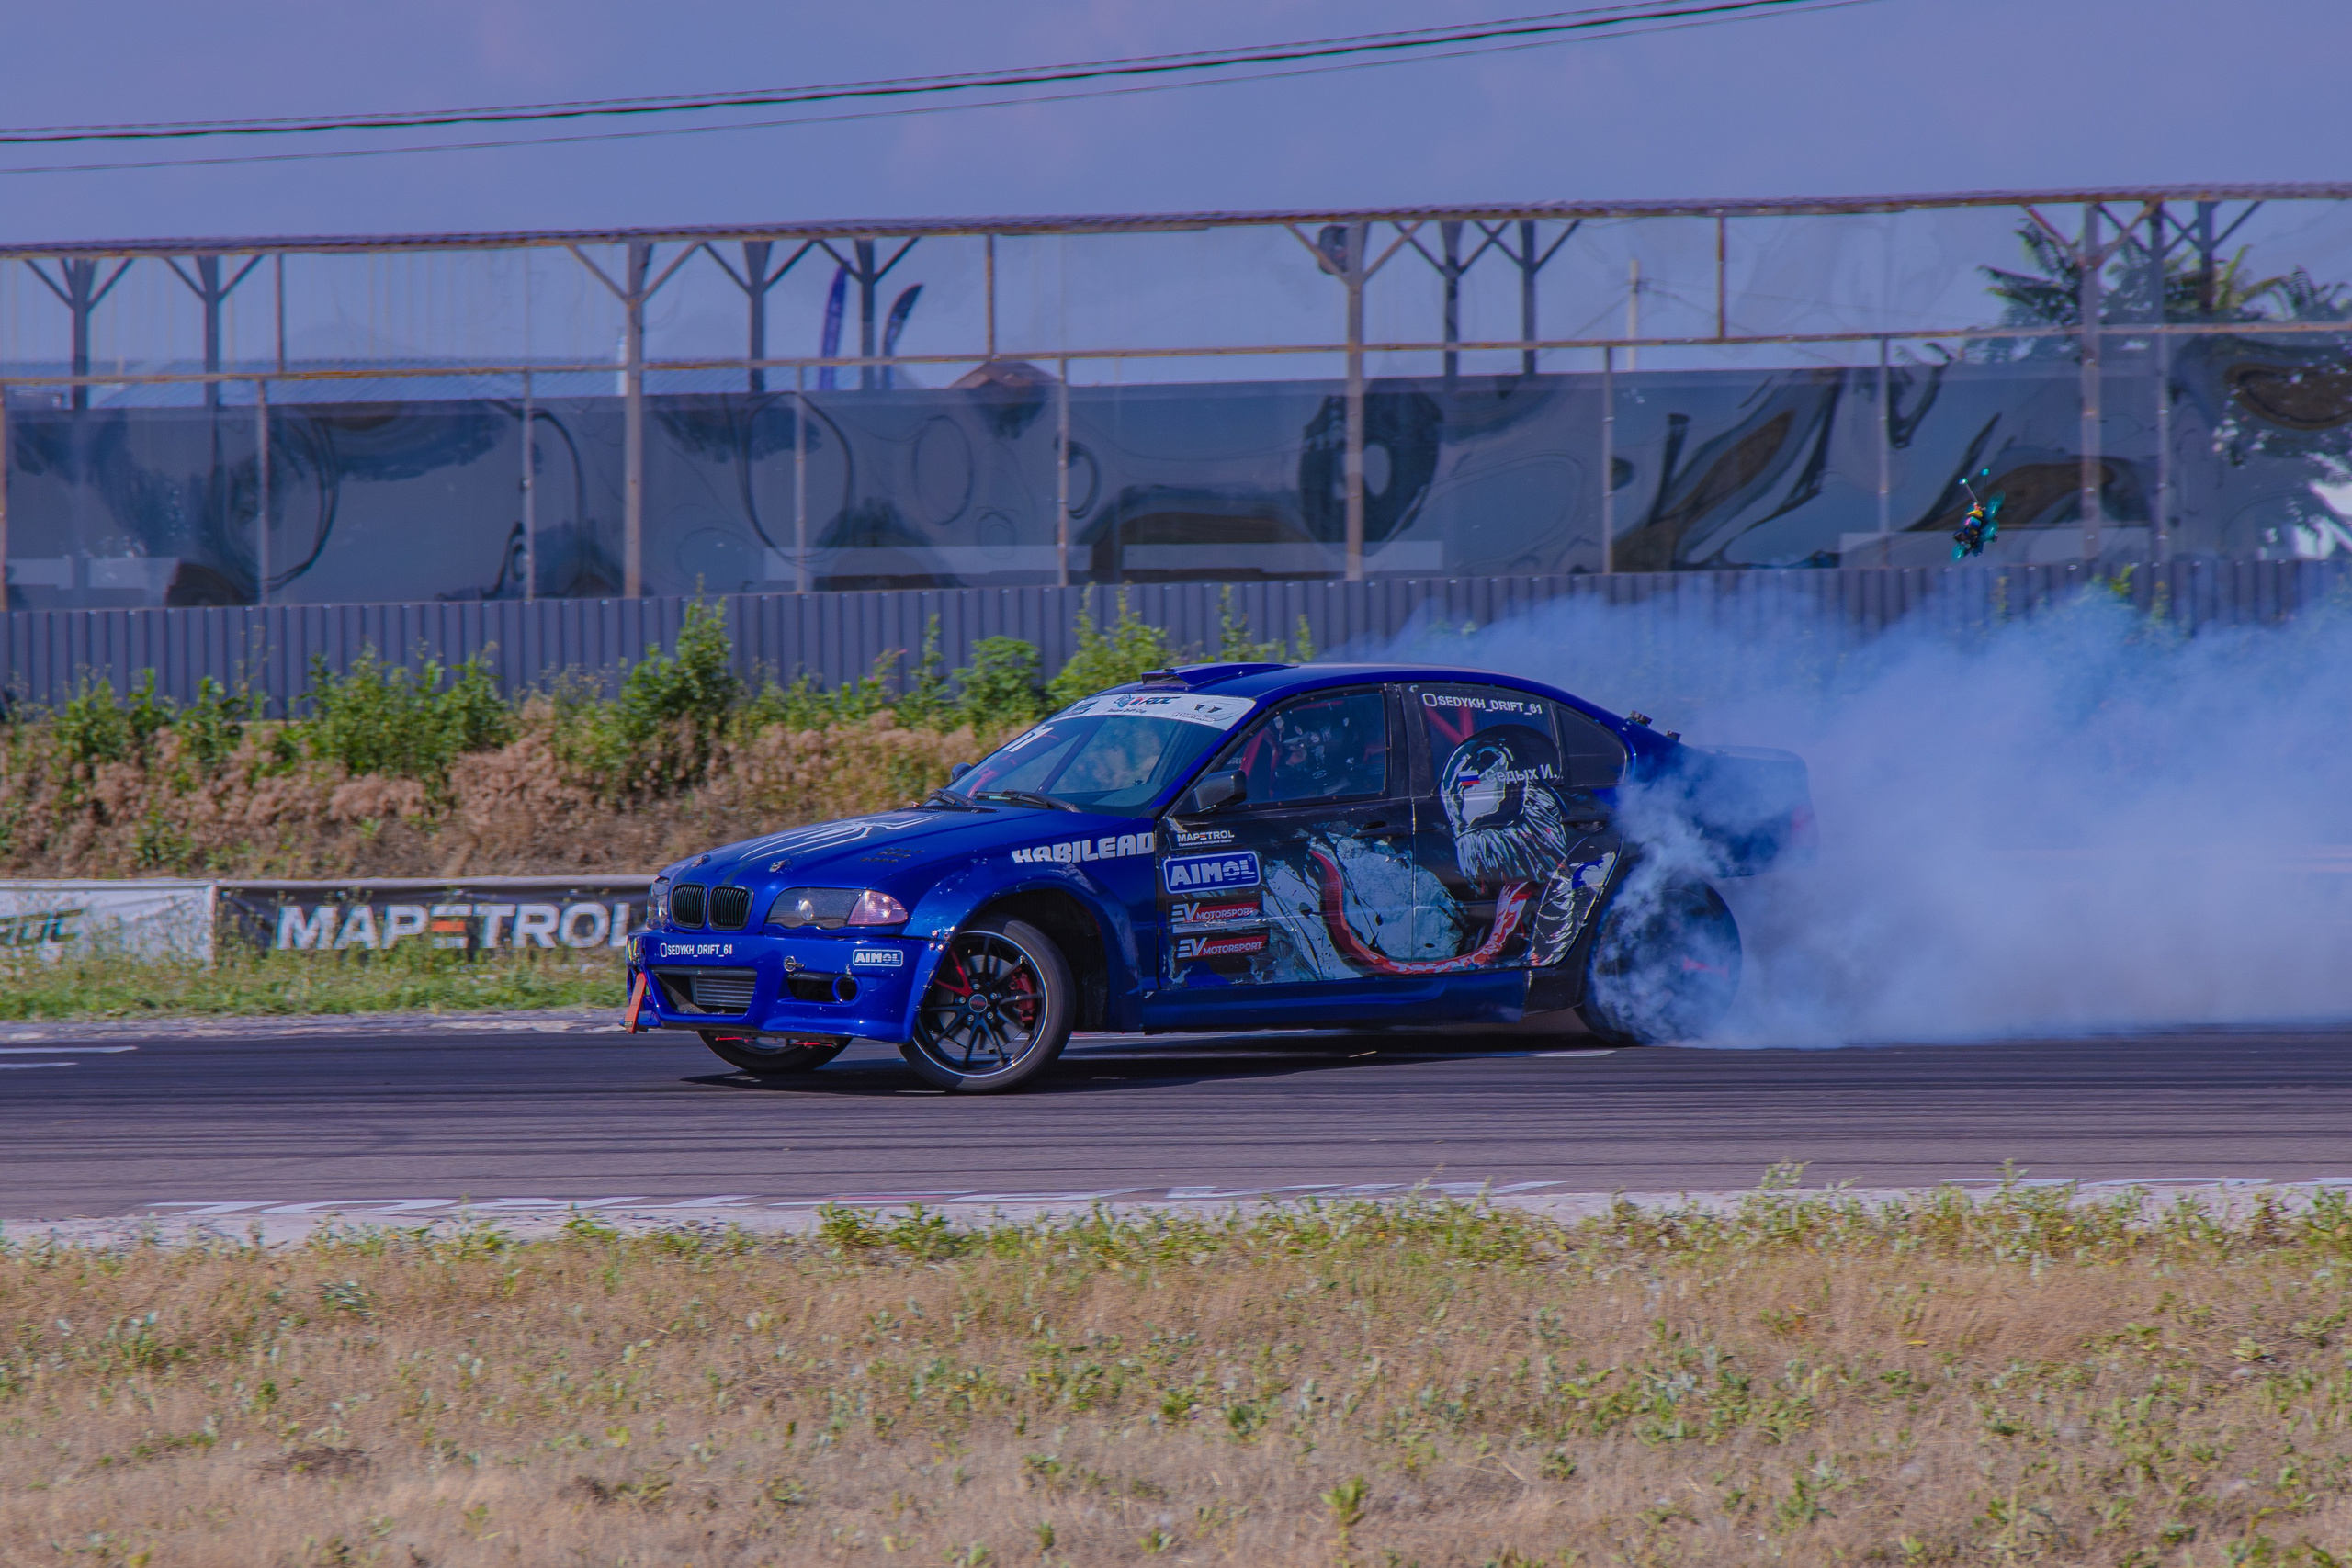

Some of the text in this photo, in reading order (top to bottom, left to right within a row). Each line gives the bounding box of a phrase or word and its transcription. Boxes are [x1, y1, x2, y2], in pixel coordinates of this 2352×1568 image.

[1176, 829, 1235, 842] MAPETROL
[1012, 832, 1155, 863] HABILEAD
[1170, 859, 1256, 886] AIMOL
[1196, 907, 1255, 920] MOTORSPORT
[277, 903, 631, 950] MAPETROL
[1203, 941, 1263, 956] MOTORSPORT
[854, 953, 900, 964] AIMOL
